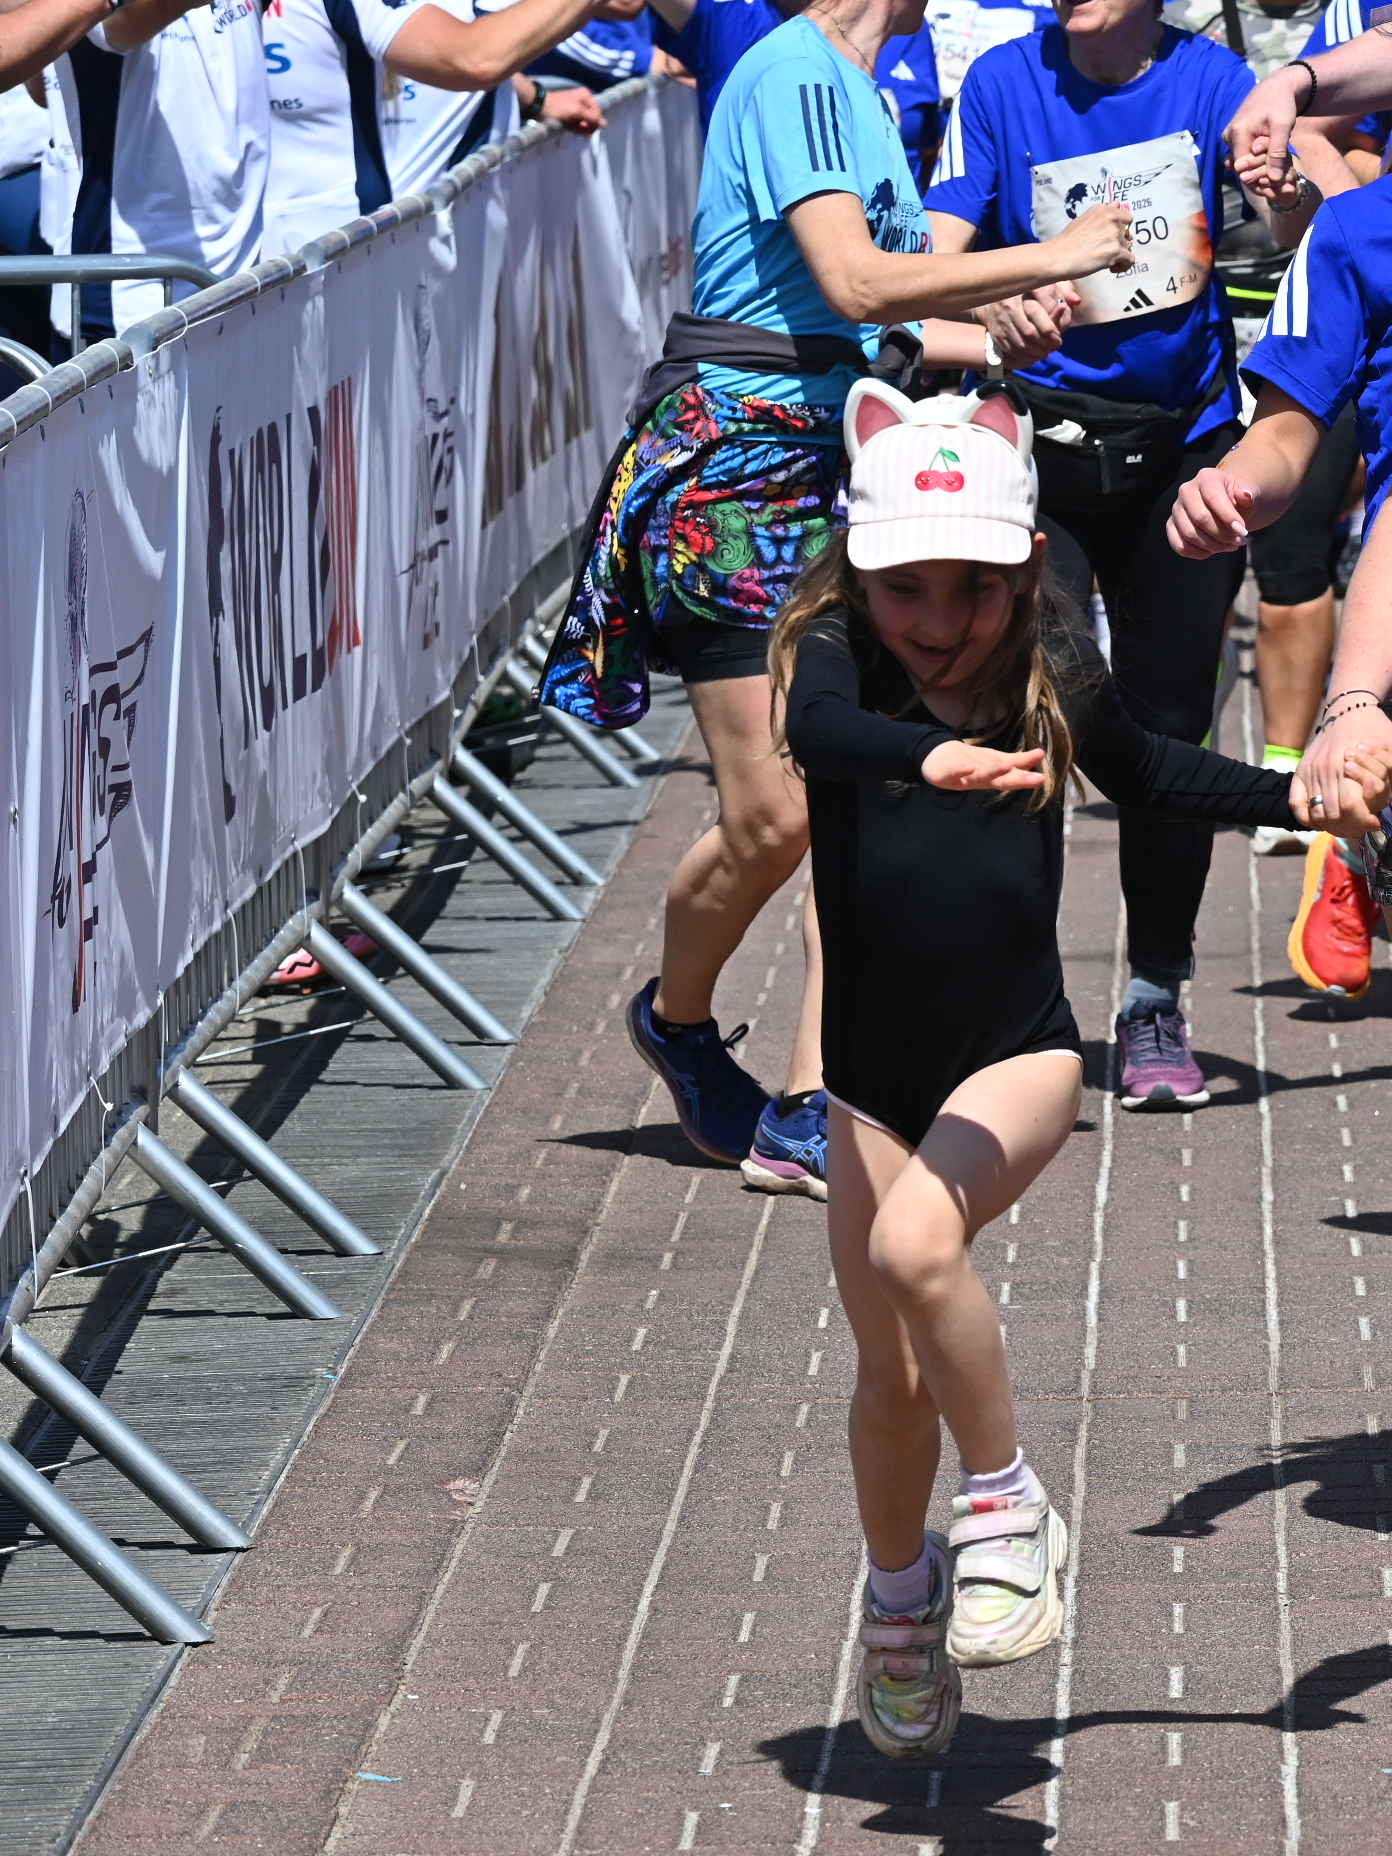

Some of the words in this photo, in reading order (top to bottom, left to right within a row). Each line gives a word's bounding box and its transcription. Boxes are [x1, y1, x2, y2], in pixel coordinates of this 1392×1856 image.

[1091, 175, 1142, 195] WINGS
[1132, 198, 1152, 211] 2026
[1166, 276, 1178, 294] 4
